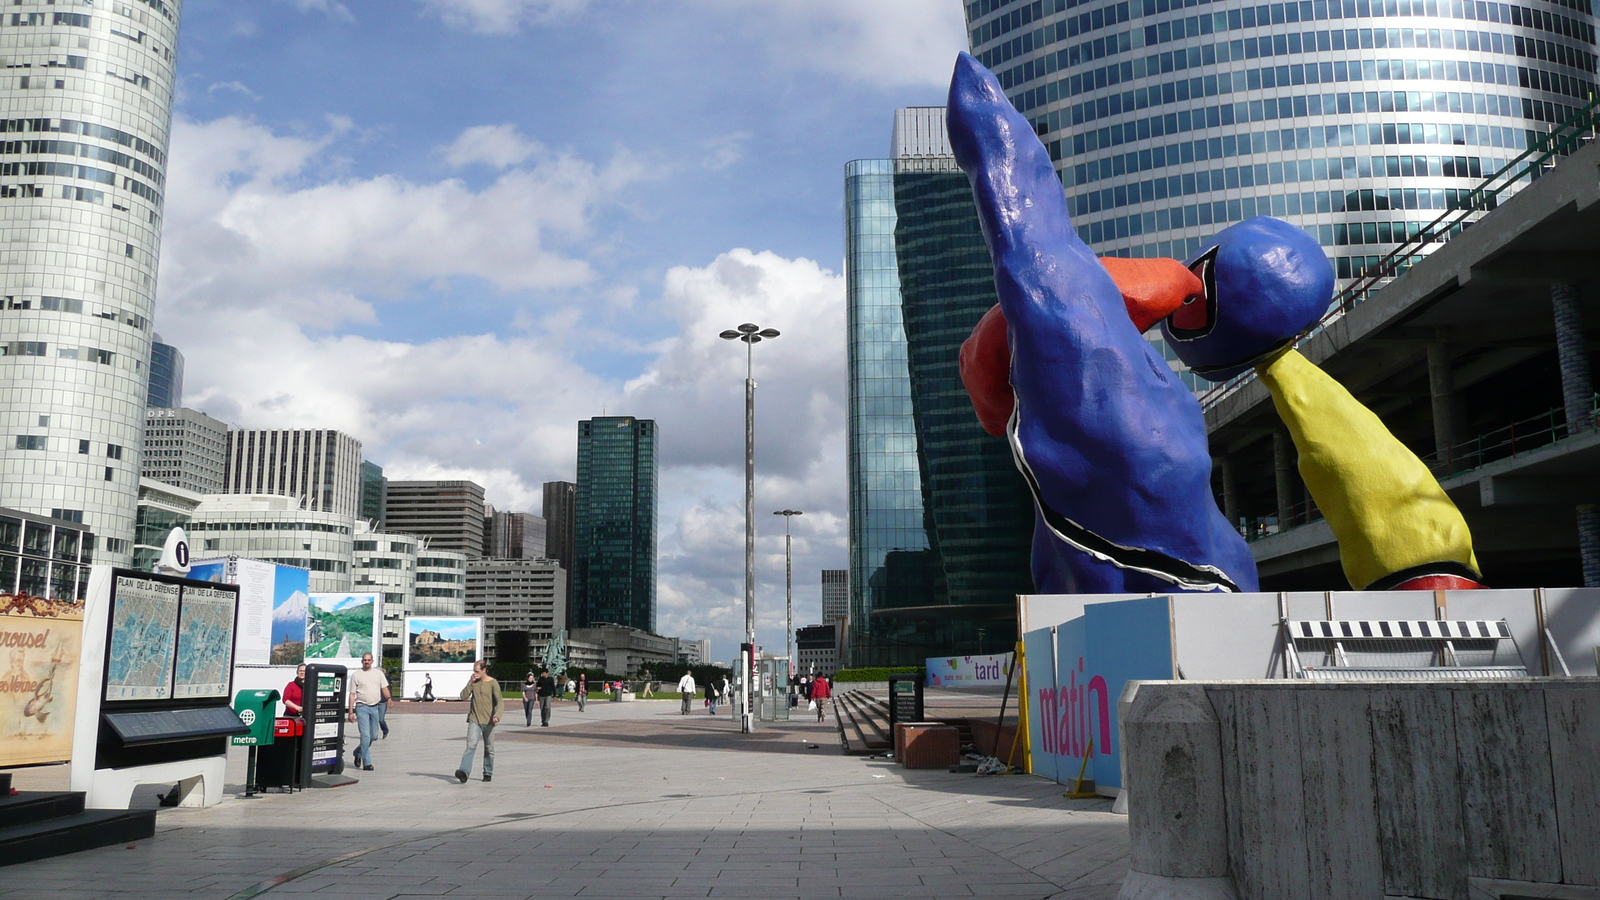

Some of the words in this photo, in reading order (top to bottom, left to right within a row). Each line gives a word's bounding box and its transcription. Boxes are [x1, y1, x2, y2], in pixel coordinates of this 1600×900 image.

[118, 578, 134, 588] PLAN
[136, 581, 145, 590] DE
[145, 582, 153, 591] LA
[182, 587, 196, 596] PLAN
[197, 588, 205, 597] DE
[205, 589, 213, 598] LA
[975, 660, 1000, 680] tard
[10, 675, 38, 693] Verne
[1039, 656, 1112, 758] matin
[233, 736, 257, 744] metro
